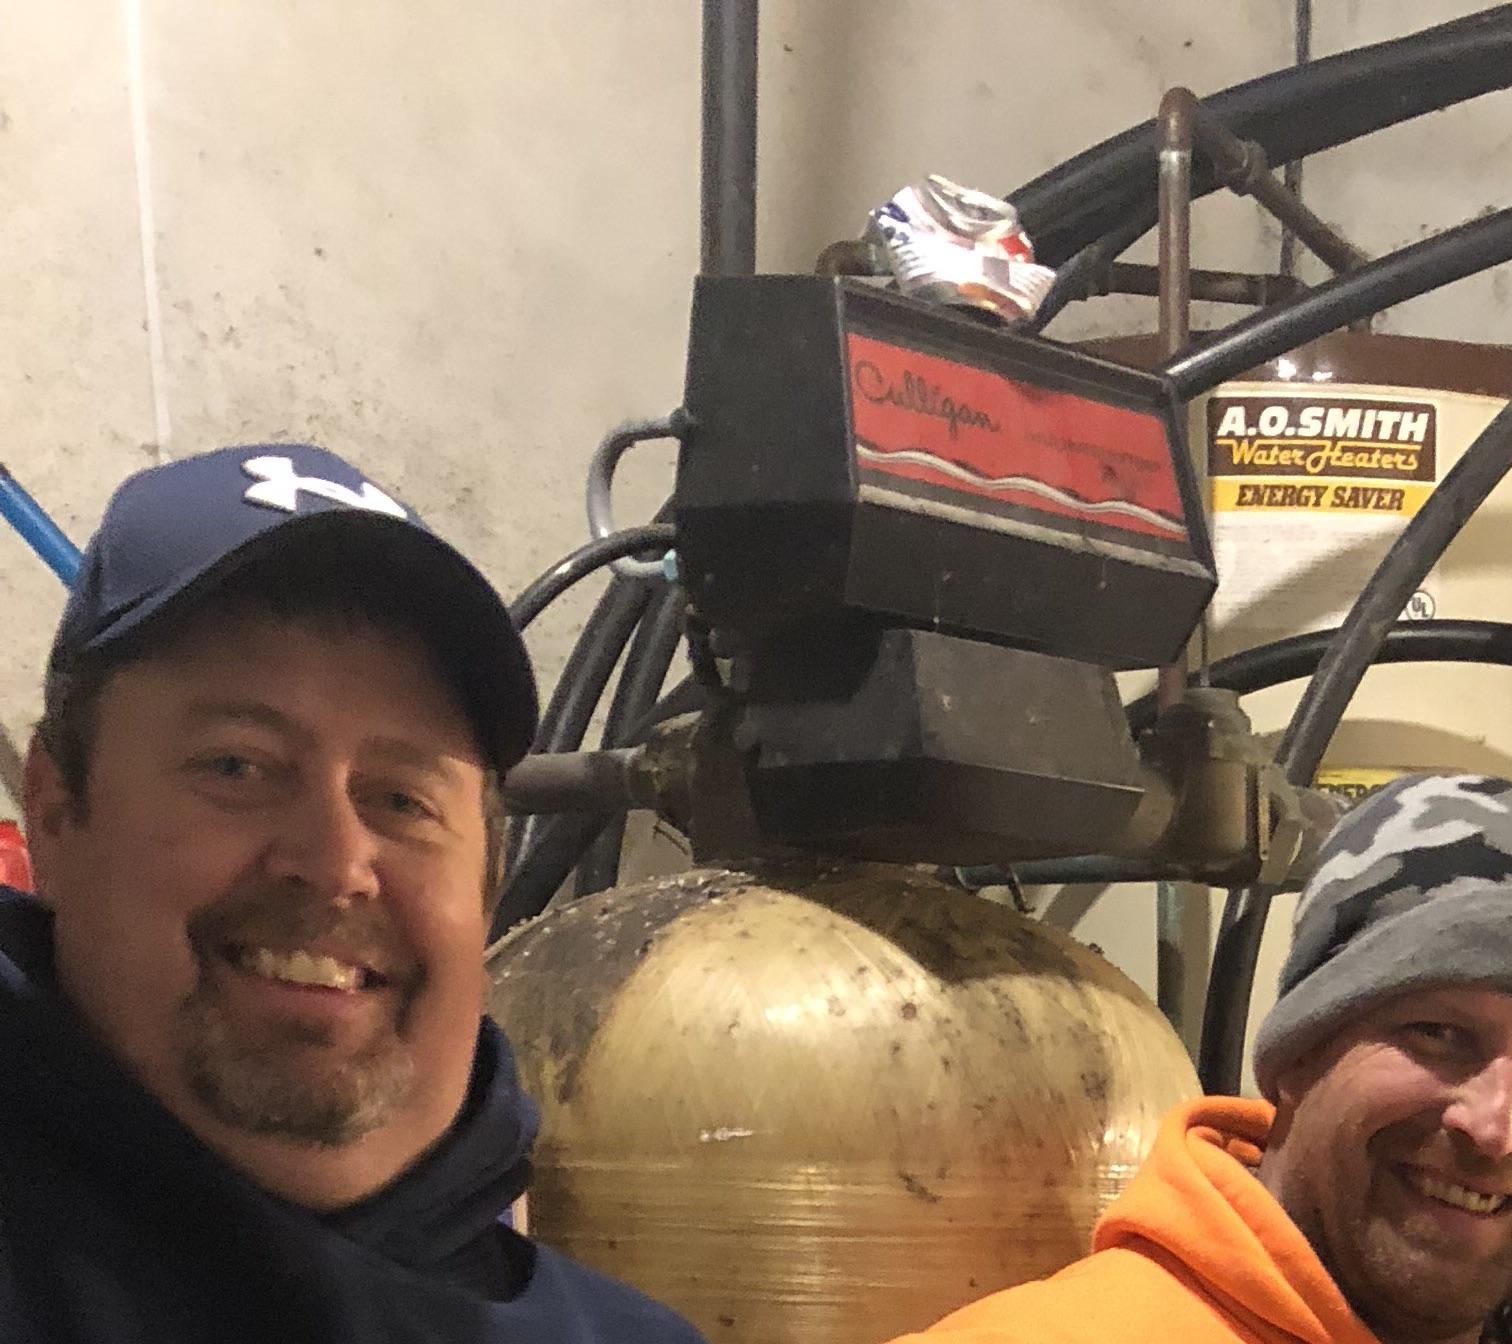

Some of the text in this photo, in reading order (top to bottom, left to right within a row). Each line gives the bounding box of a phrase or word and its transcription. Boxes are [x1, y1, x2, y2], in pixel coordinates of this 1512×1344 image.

[855, 360, 1001, 441] Culligan
[1231, 439, 1419, 474] Water Heaters
[1235, 484, 1405, 511] ENERGY SAVER
